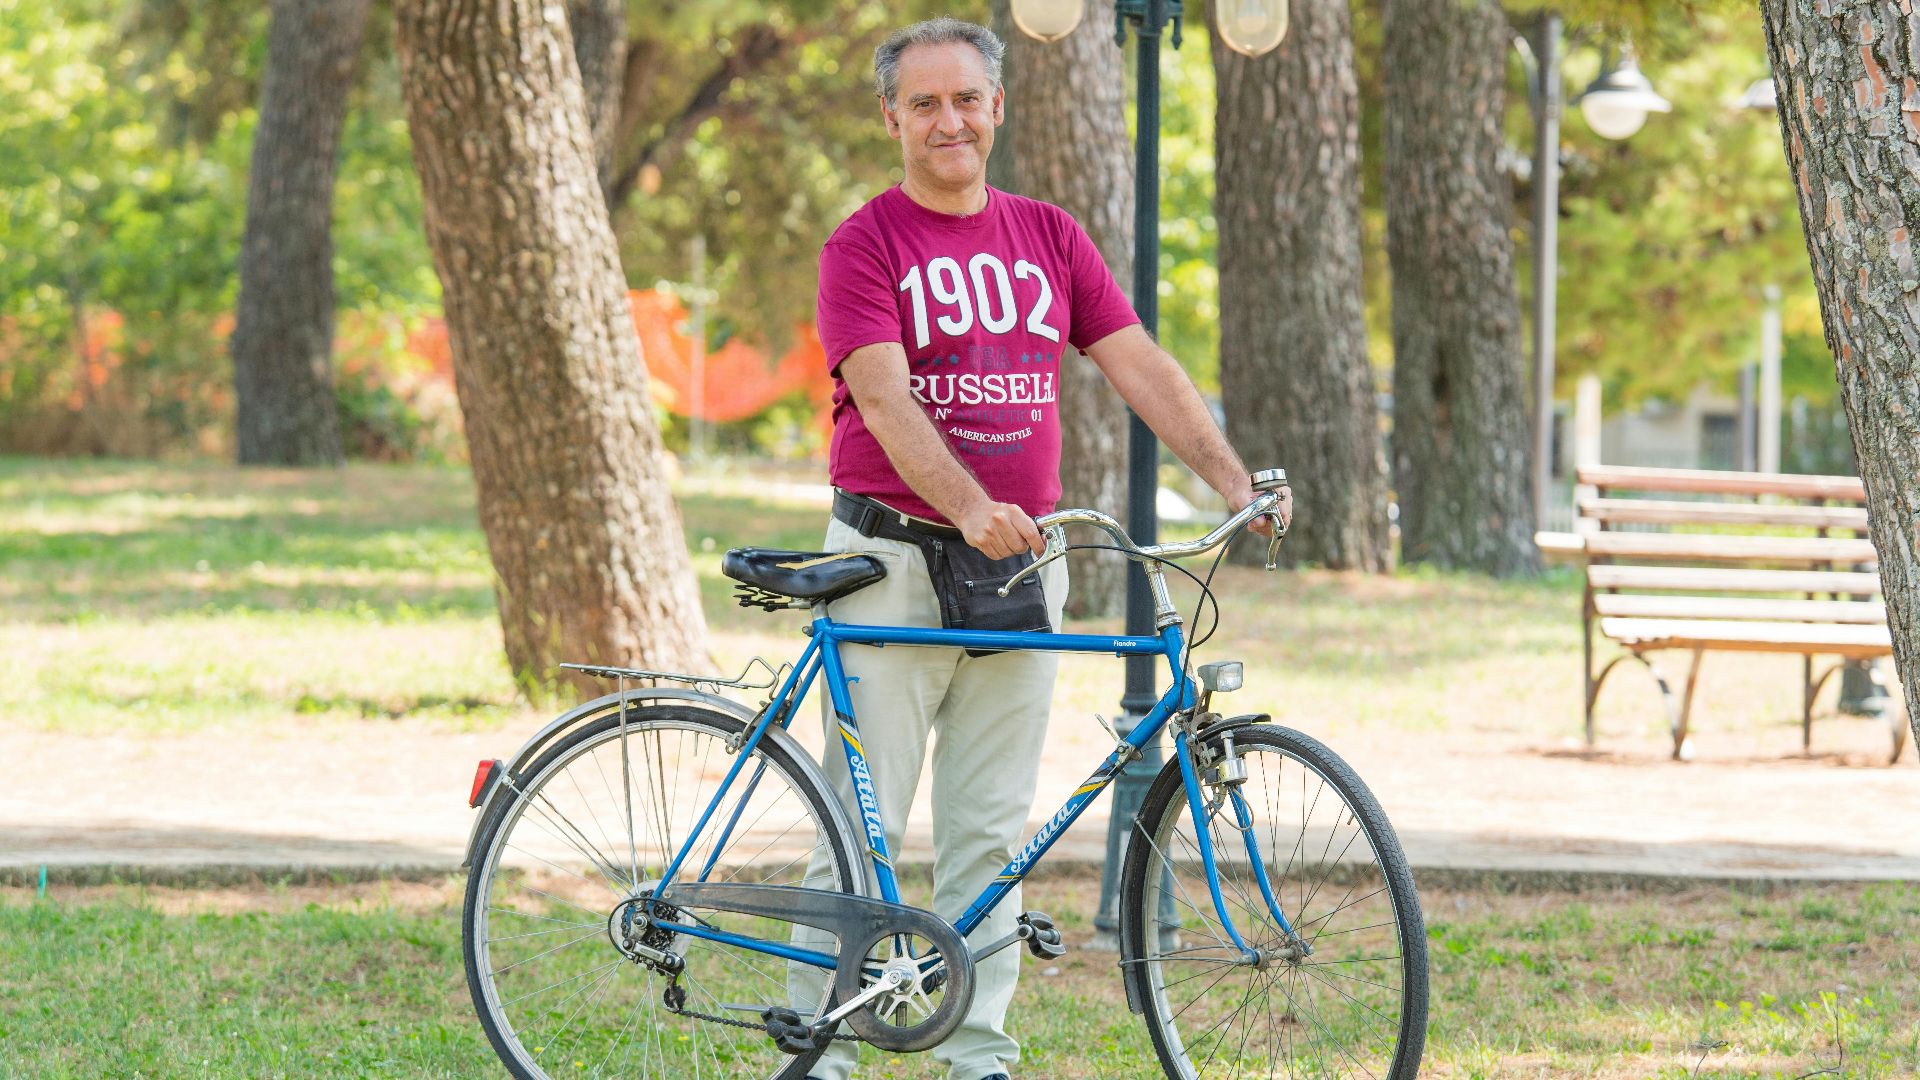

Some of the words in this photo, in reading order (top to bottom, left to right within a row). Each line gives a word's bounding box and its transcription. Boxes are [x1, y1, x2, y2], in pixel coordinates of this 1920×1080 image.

[900, 252, 1060, 350] 1902
[910, 372, 1056, 405] RUSSELL
[949, 426, 1005, 443] AMERICAN
[1006, 427, 1033, 442] STYLE
[1030, 409, 1043, 422] 01
[850, 755, 882, 848] Atala
[1011, 803, 1078, 873] Atala
